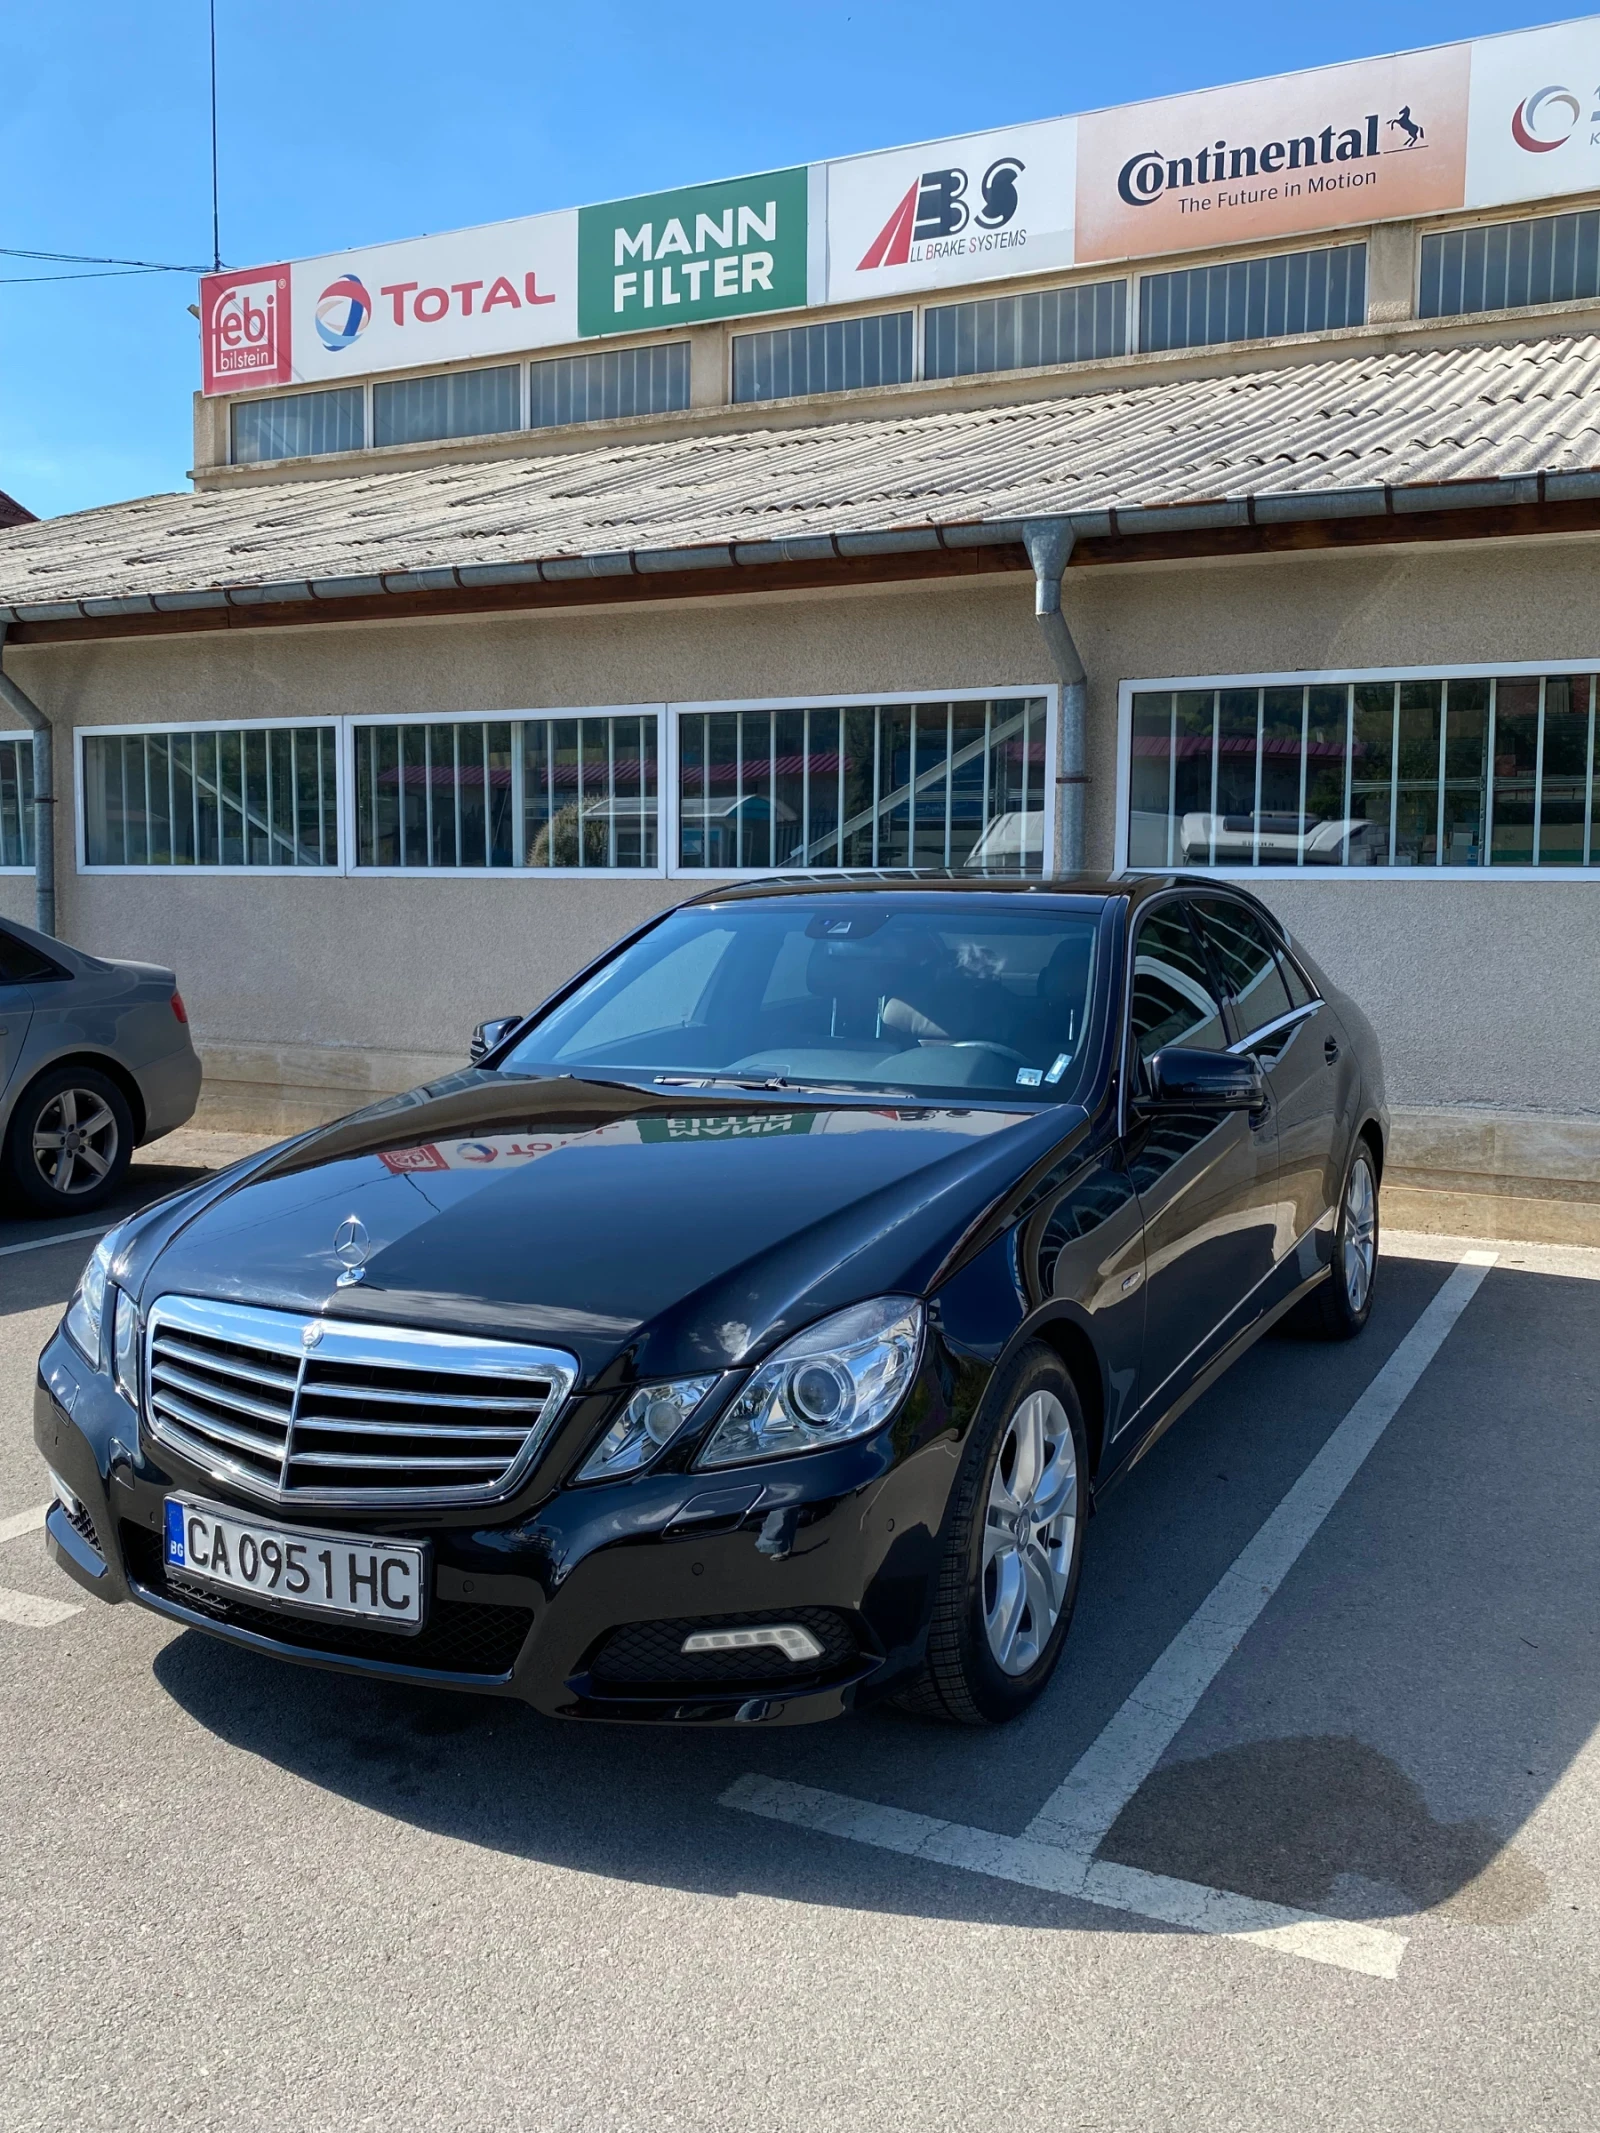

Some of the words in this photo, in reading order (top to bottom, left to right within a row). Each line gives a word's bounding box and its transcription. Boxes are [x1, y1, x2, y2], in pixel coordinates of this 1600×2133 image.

[1117, 114, 1379, 206] Continental
[1178, 198, 1211, 214] The
[1218, 188, 1278, 210] Future
[1285, 182, 1301, 197] in
[1308, 171, 1376, 194] Motion
[614, 201, 776, 267] MANN
[926, 239, 966, 261] BRAKE
[969, 229, 1027, 254] SYSTEMS
[381, 272, 555, 326] TOTAL
[614, 251, 774, 313] FILTER
[212, 290, 275, 347] febi
[220, 348, 269, 370] bilstein
[170, 1540, 184, 1558] BG
